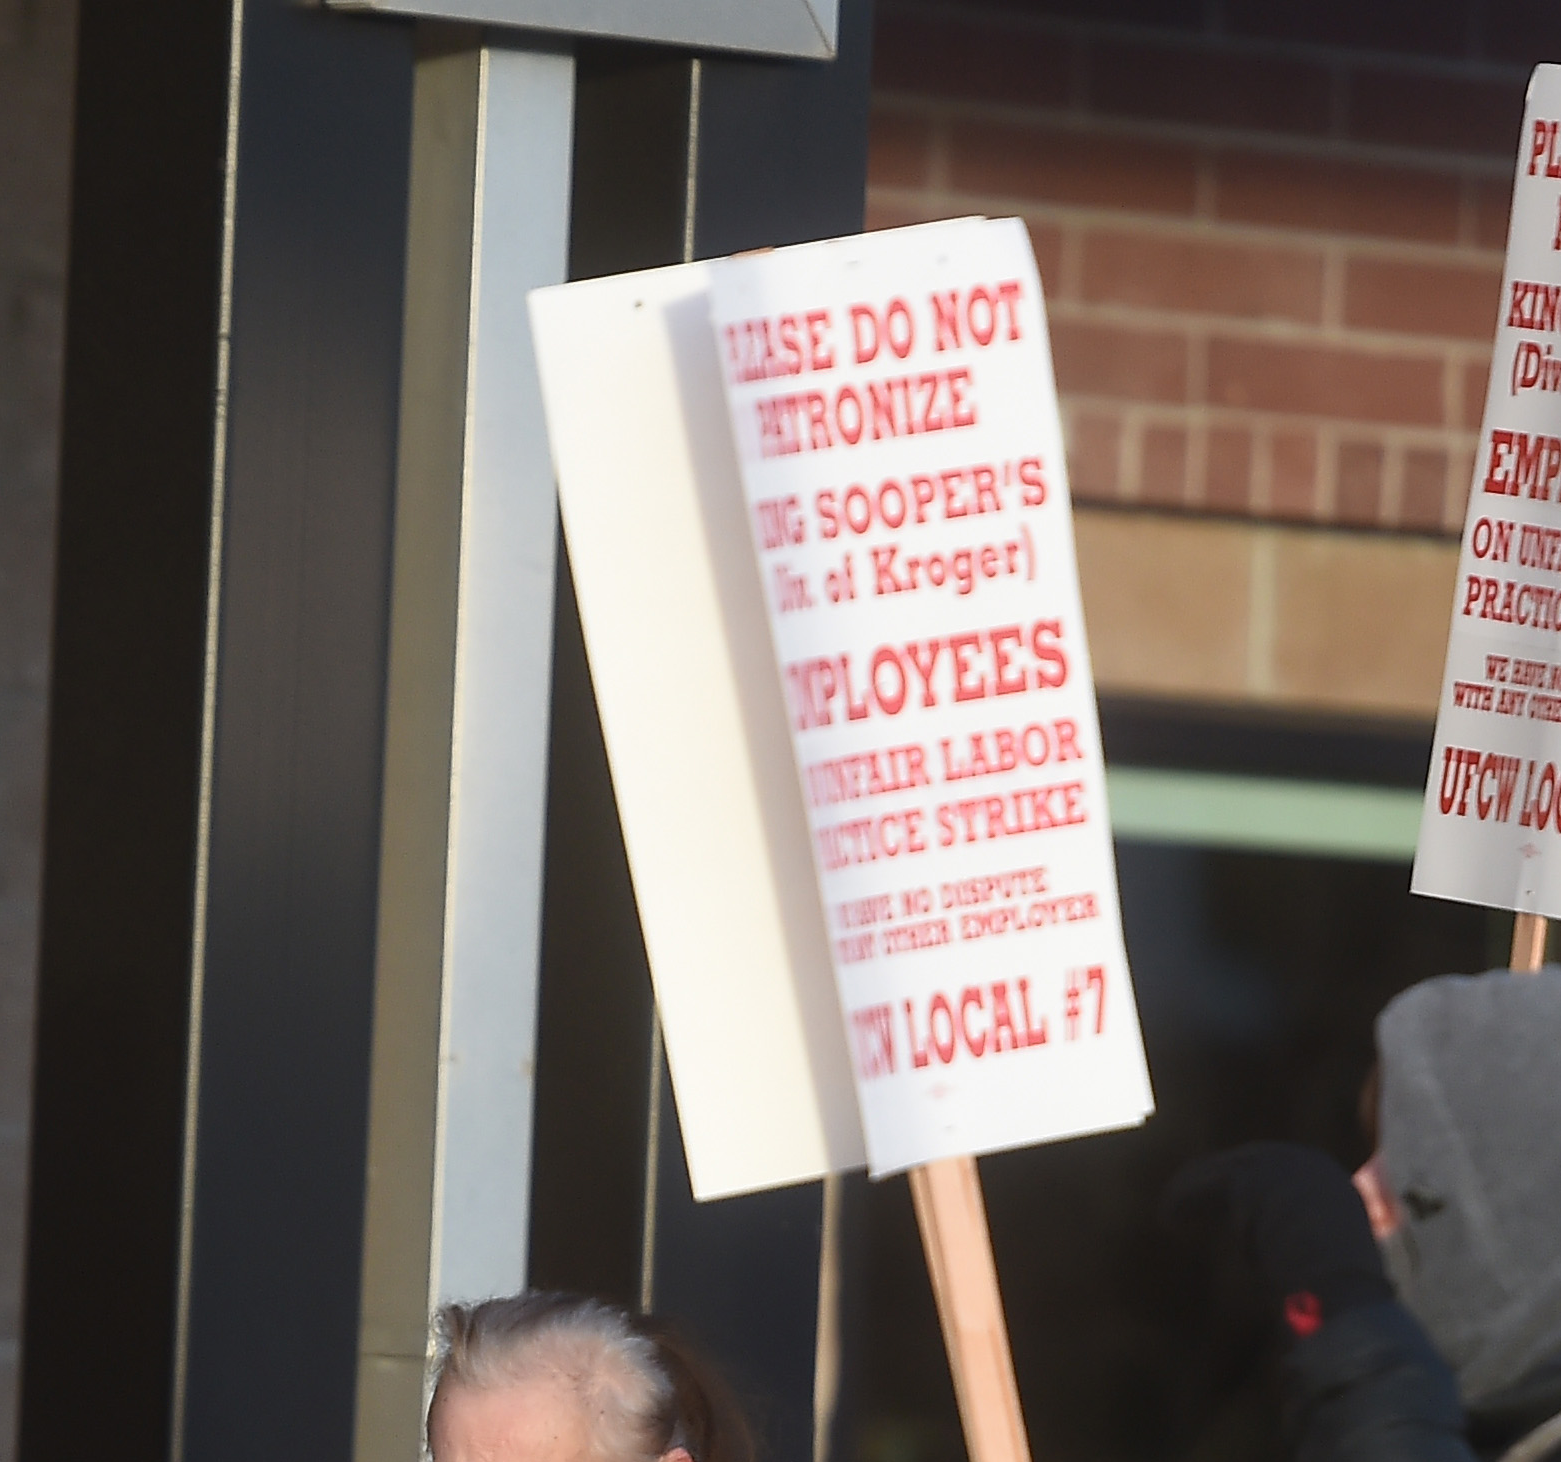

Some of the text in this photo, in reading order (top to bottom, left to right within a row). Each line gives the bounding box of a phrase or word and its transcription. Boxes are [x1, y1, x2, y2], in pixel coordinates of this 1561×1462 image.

[849, 298, 915, 364] DO
[931, 281, 1022, 352] NOT
[817, 458, 1048, 539] SOOPER'S
[826, 554, 857, 604] of
[871, 528, 1035, 596] Kroger)
[1472, 518, 1516, 562] ON
[940, 718, 1084, 782] LABOR
[1439, 747, 1521, 820] UFCW
[937, 781, 1087, 848] STRIKE
[902, 888, 932, 916] NO
[905, 978, 1049, 1069] LOCAL
[1063, 965, 1107, 1042] #7
